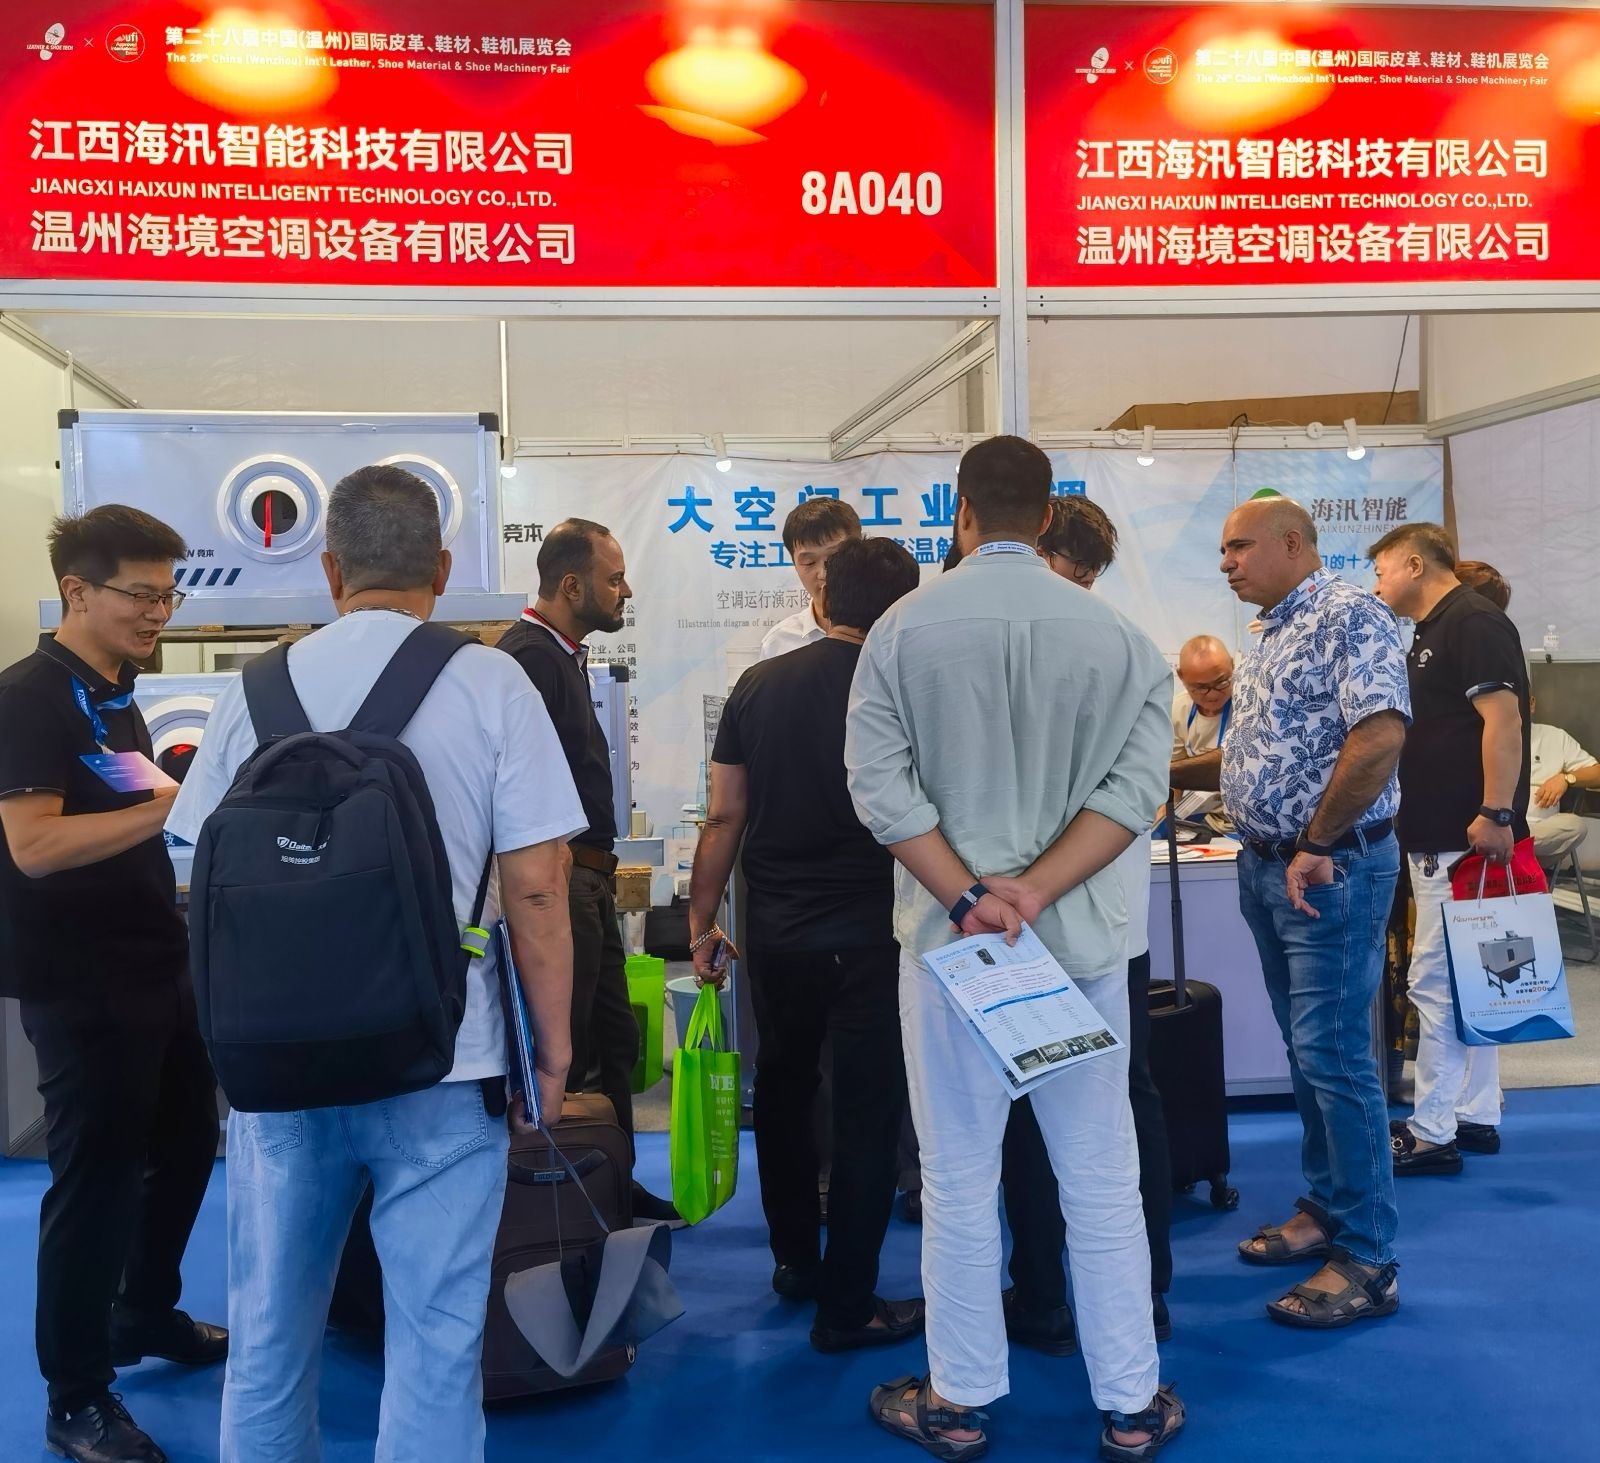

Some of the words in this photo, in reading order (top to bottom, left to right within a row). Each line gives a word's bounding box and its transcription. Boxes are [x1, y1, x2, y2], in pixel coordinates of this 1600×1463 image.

[166, 52, 187, 63] The
[329, 57, 375, 69] Leather,
[377, 58, 404, 70] Shoe
[407, 60, 451, 71] Material
[454, 61, 462, 72] &
[465, 61, 491, 72] Shoe
[494, 63, 547, 75] Machinery
[550, 64, 571, 74] Fair
[1337, 74, 1377, 85] Leather,
[1379, 74, 1402, 84] Shoe
[1404, 74, 1444, 84] Material
[1445, 75, 1453, 84] &
[1455, 75, 1479, 85] Shoe
[1480, 76, 1528, 87] Machinery
[1529, 76, 1549, 86] Fair
[28, 118, 574, 176] 江西海汛智能科技有限公司
[1075, 138, 1549, 180] 江西海汛智能科技有限公司
[30, 177, 114, 196] JIANGXI
[118, 181, 197, 199] HAIXUN
[201, 183, 332, 202] INTELLIGENT
[336, 186, 474, 206] TECHNOLOGY
[477, 189, 558, 208] CO.,LTD.
[801, 170, 943, 216] 8A040
[1076, 195, 1147, 210] JIANGXI
[1150, 195, 1217, 210] HAIXUN
[1221, 194, 1335, 209] INTELLIGENT
[1338, 193, 1459, 209] TECHNOLOGY
[1462, 193, 1533, 210] CO.,LTD.
[30, 209, 577, 265] 温州海境空调设备有限公司
[1075, 222, 1550, 265] 温州海境空调设备有限公司
[1311, 496, 1408, 522] 海汛智能
[677, 618, 721, 629] Illustration
[723, 618, 750, 630] diagram
[751, 618, 760, 627] of
